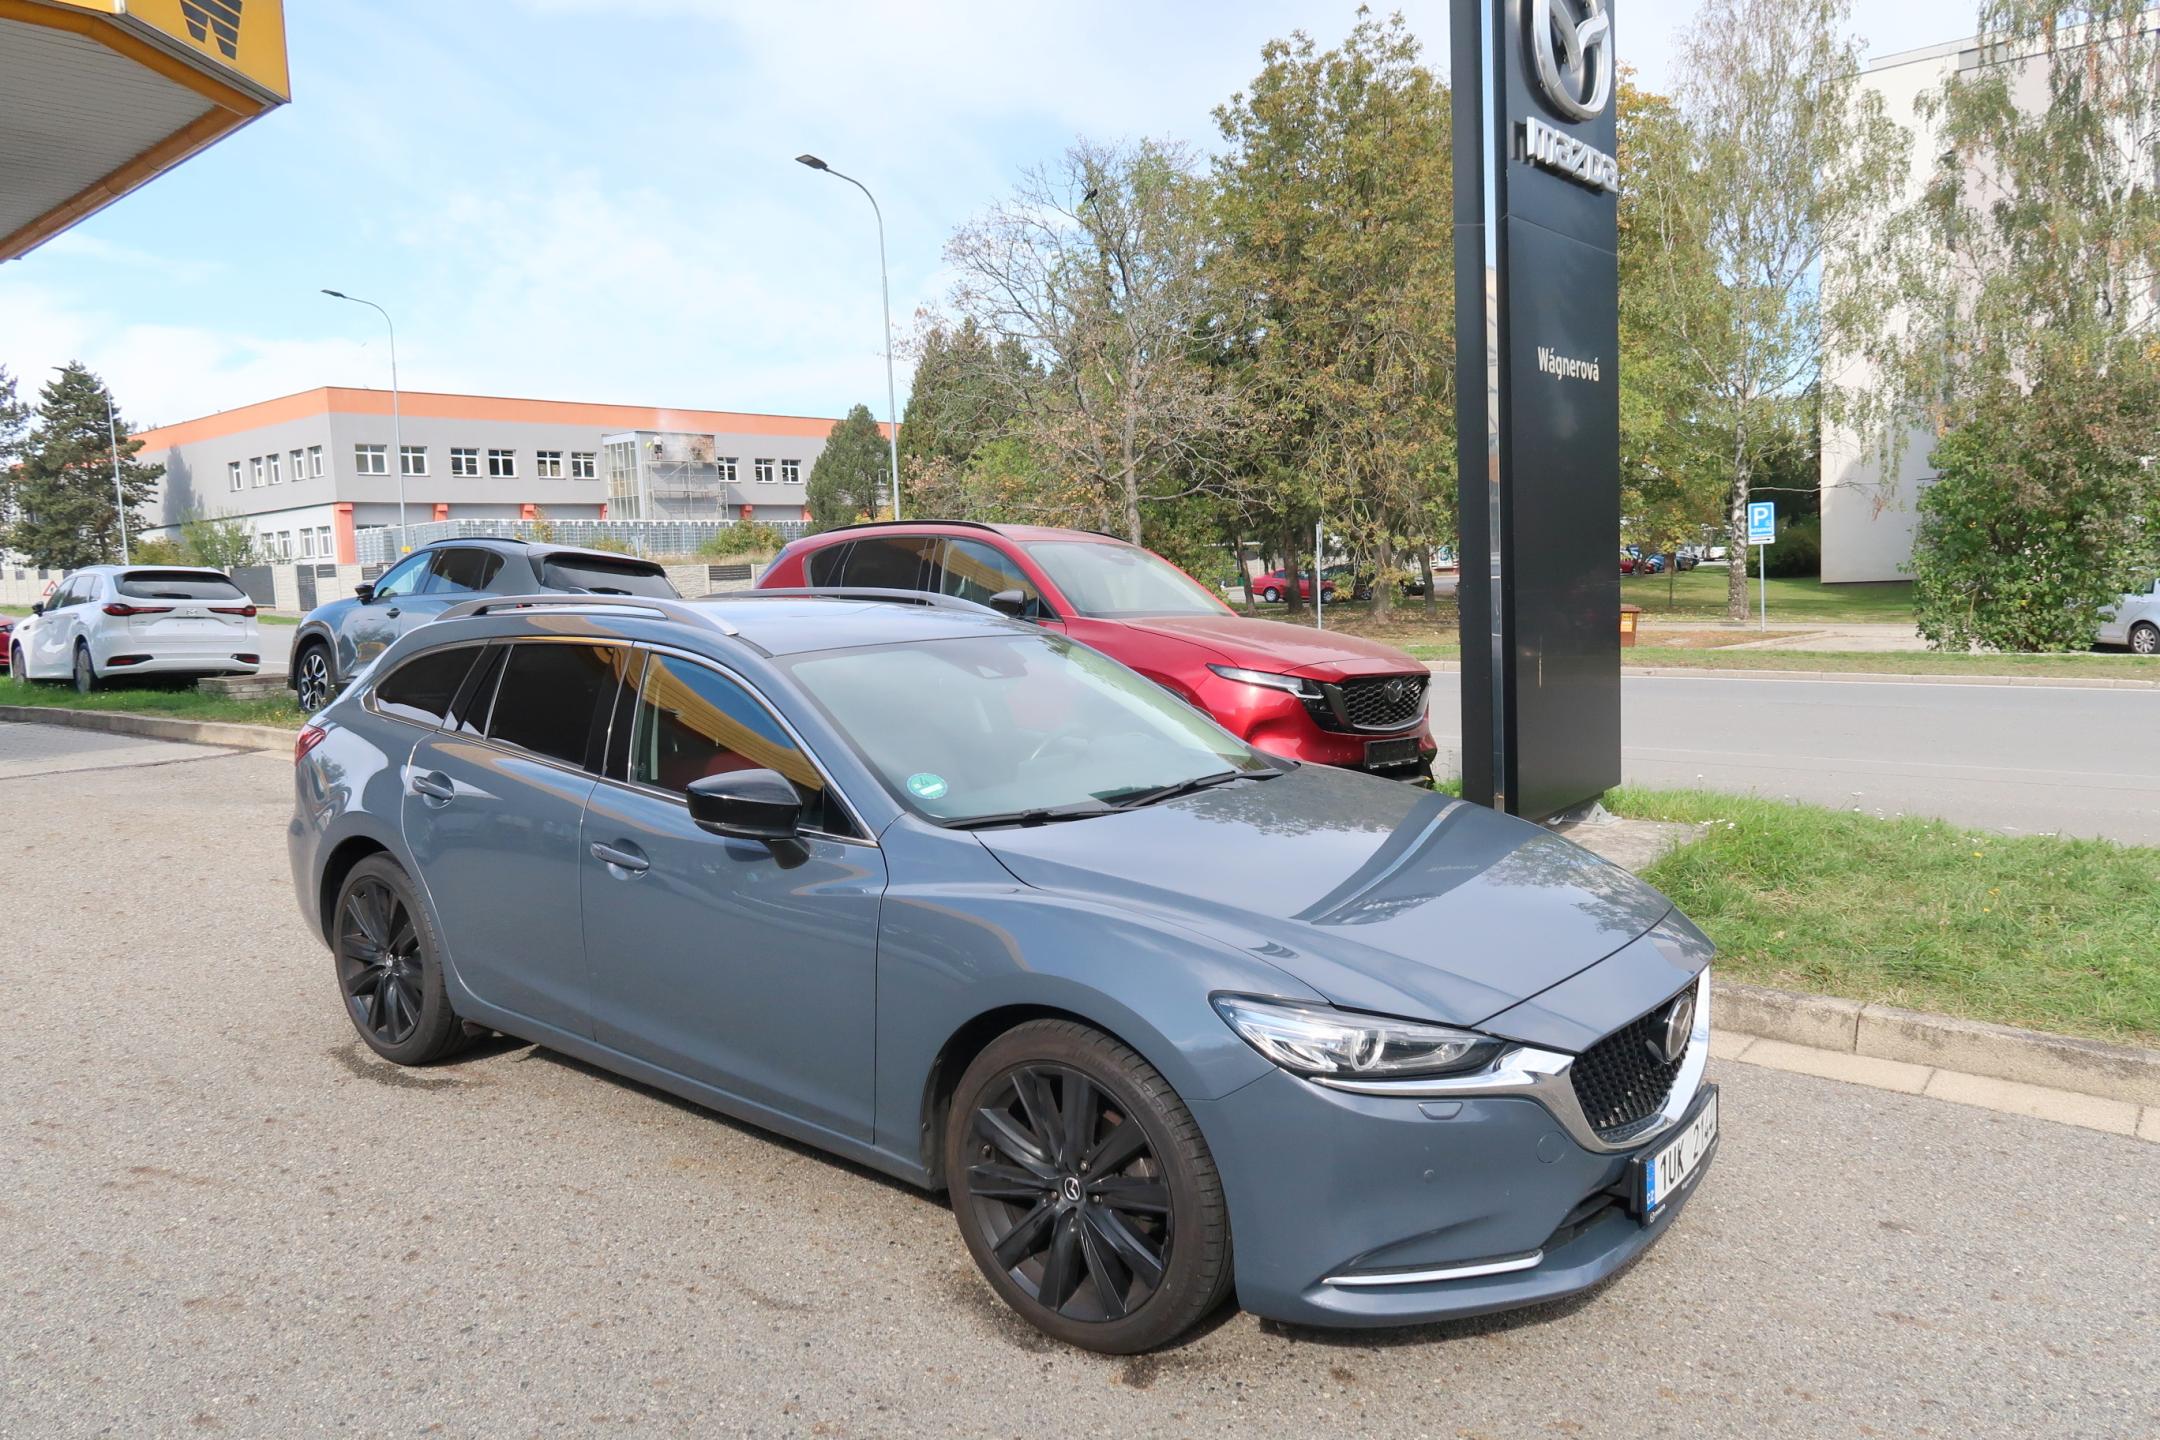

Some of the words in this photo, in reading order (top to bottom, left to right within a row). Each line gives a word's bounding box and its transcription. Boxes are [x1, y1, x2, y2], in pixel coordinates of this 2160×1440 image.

[1537, 345, 1600, 382] Wágnerová
[1753, 507, 1769, 526] P
[1660, 1139, 1684, 1191] 1UK
